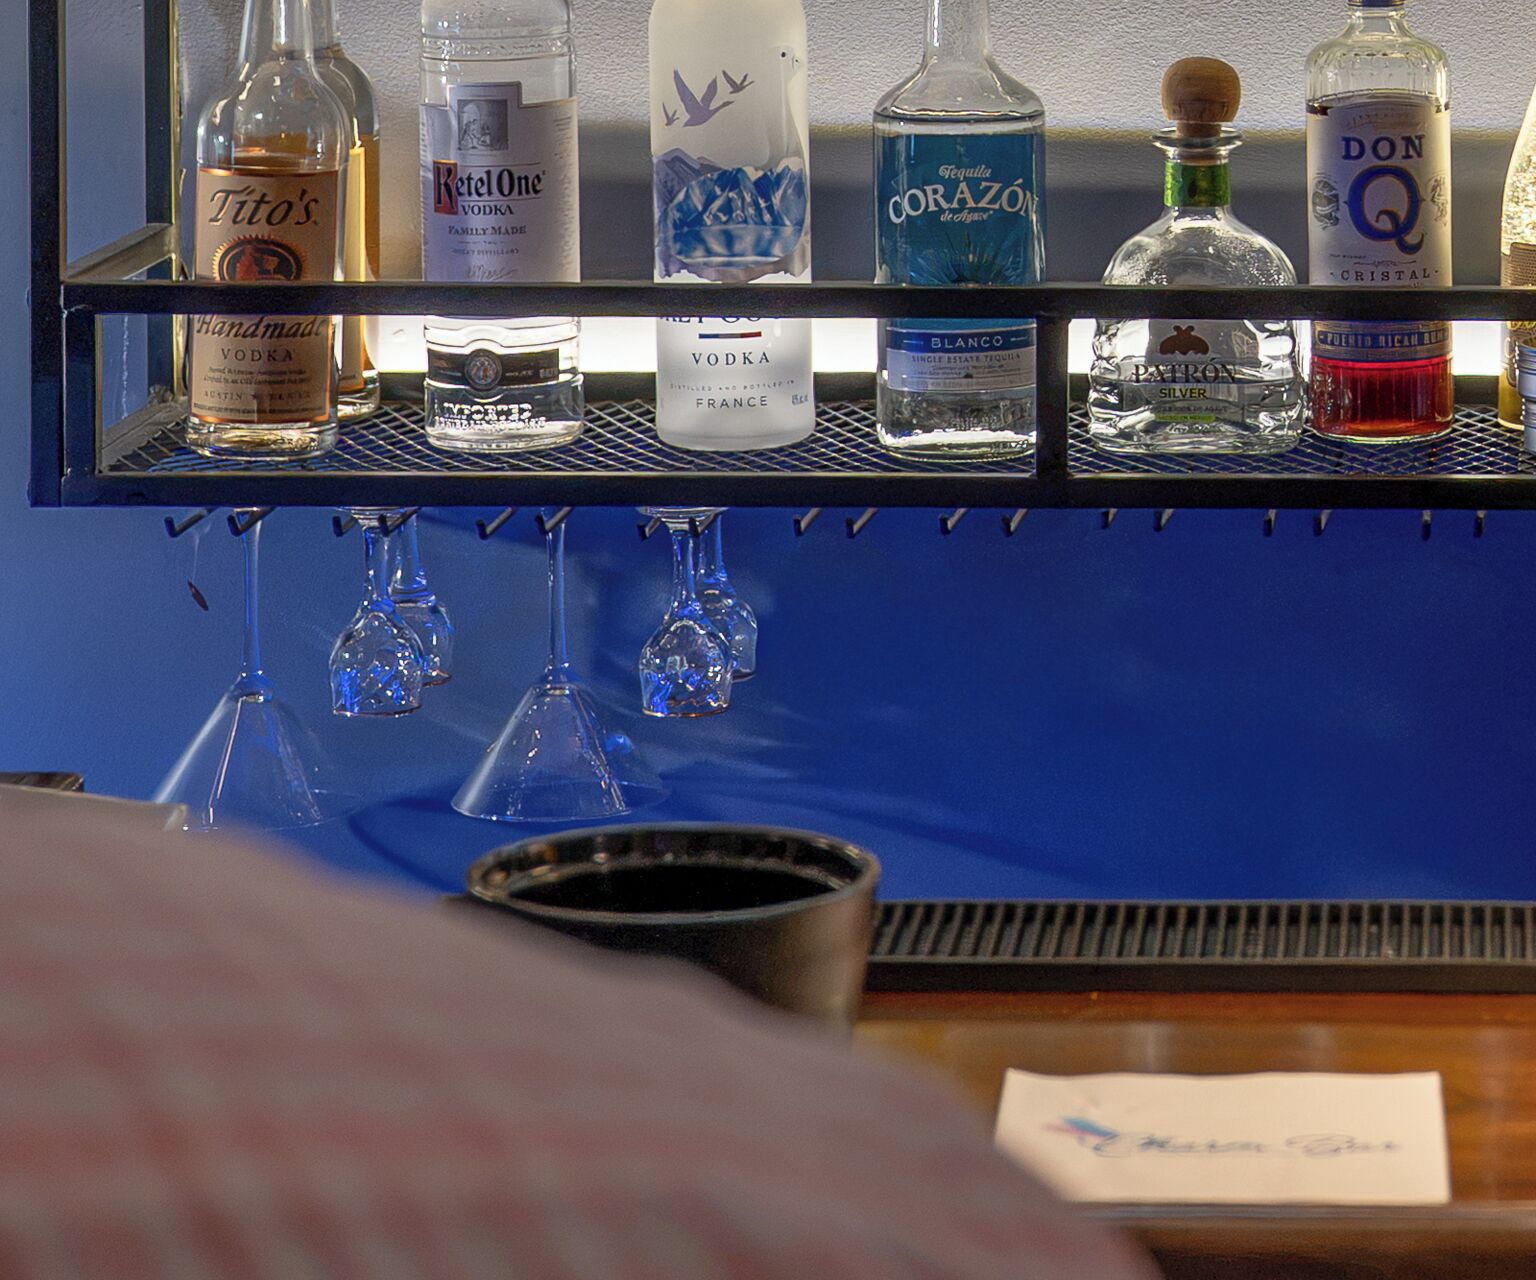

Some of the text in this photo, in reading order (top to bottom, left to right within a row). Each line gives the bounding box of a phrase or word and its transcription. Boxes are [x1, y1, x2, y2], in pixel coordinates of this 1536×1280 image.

[1341, 134, 1426, 161] DON
[938, 163, 993, 181] Tequila
[436, 165, 543, 210] Ketel One
[208, 185, 320, 227] Tito's
[888, 178, 1039, 225] CORAZÓN
[1345, 163, 1428, 255] Q
[460, 204, 515, 216] VODKA
[448, 224, 527, 237] FAMILY MADE
[1340, 267, 1431, 282] CRISTAL
[930, 336, 1003, 349] BLANCO
[221, 347, 293, 362] VODKA
[691, 351, 771, 367] VODKA
[1131, 357, 1239, 384] PATRÓN
[1159, 387, 1208, 400] SILVER
[696, 395, 769, 409] FRANCE
